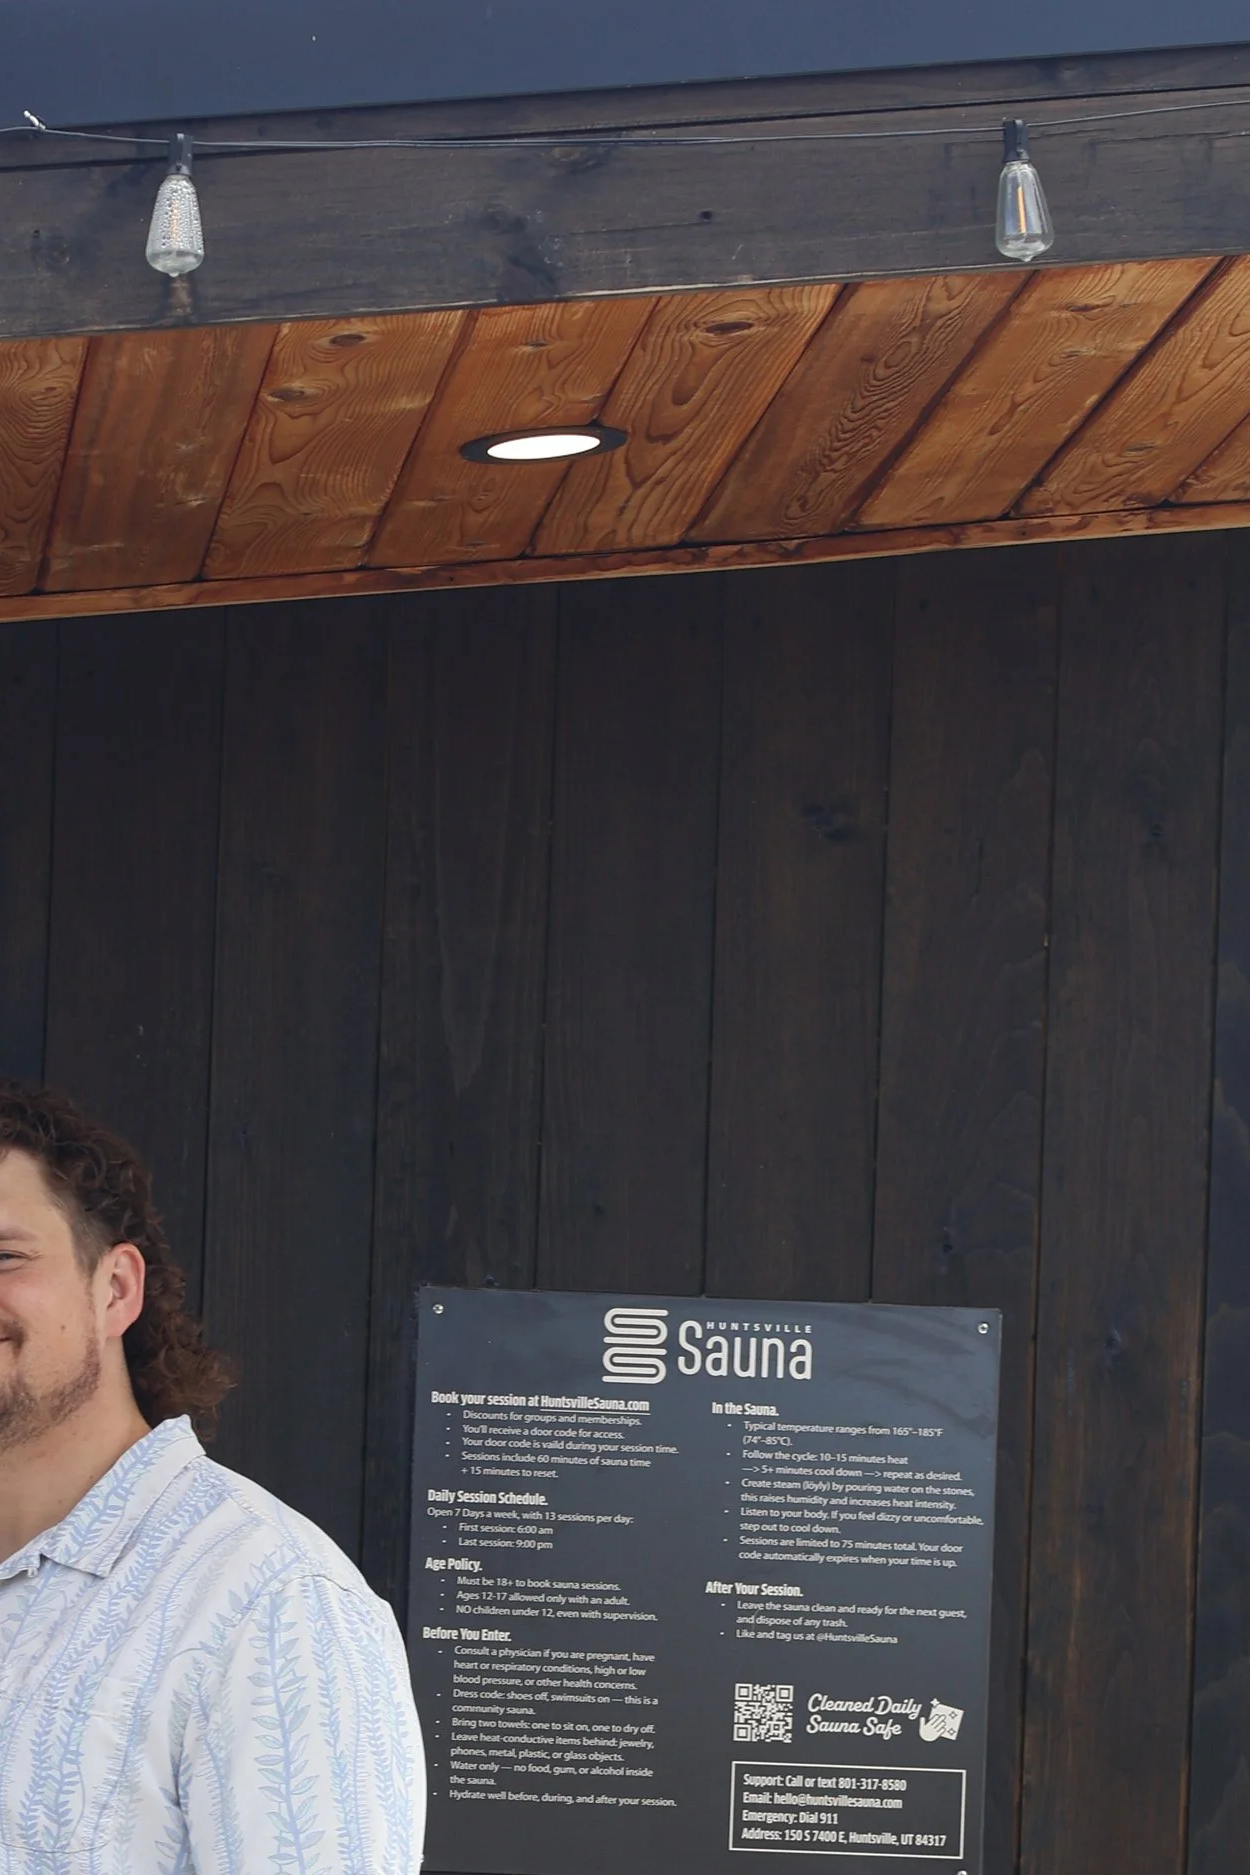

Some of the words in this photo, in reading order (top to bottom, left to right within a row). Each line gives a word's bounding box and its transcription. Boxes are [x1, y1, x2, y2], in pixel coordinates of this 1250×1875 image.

[706, 1321, 813, 1334] HUNTSVILLE
[678, 1320, 813, 1380] Sauna
[431, 1391, 459, 1403] Book
[460, 1394, 486, 1405] your
[486, 1394, 526, 1405] session
[527, 1395, 539, 1406] at
[540, 1395, 649, 1410] HuntsvilleSauna.com
[711, 1401, 723, 1413] In
[724, 1402, 742, 1414] the
[743, 1403, 779, 1416] Sauna.
[463, 1410, 508, 1420] Discounts
[509, 1411, 523, 1420] for
[523, 1414, 557, 1423] groups
[557, 1414, 576, 1422] and
[577, 1415, 642, 1426] memberships.
[743, 1420, 776, 1431] Typical
[776, 1423, 834, 1432] temperature
[835, 1426, 867, 1435] ranges
[867, 1425, 890, 1434] from
[461, 1437, 483, 1445] Your
[484, 1437, 507, 1446] door
[507, 1439, 531, 1448] code
[532, 1439, 540, 1448] is
[564, 1440, 596, 1452] during
[597, 1444, 619, 1452] your
[619, 1443, 654, 1452] session
[654, 1444, 678, 1453] time.
[742, 1449, 773, 1458] Follow
[774, 1450, 790, 1459] the
[791, 1452, 818, 1462] cycle:
[848, 1454, 886, 1463] minutes
[886, 1454, 908, 1464] heat
[427, 1489, 456, 1503] Daily
[456, 1490, 496, 1503] Session
[497, 1492, 548, 1505] Schedule.
[426, 1506, 453, 1517] Open
[454, 1508, 461, 1516] 7
[461, 1508, 484, 1519] Days
[493, 1510, 520, 1519] week,
[521, 1510, 542, 1519] with
[544, 1511, 556, 1520] 13
[556, 1512, 595, 1521] sessions
[595, 1515, 612, 1523] per
[612, 1514, 633, 1525] day:
[458, 1522, 478, 1531] First
[479, 1524, 515, 1532] session:
[516, 1525, 537, 1533] 6:00
[458, 1537, 477, 1546] Last
[478, 1538, 514, 1547] session:
[515, 1539, 536, 1548] 9:00
[536, 1541, 553, 1550] pm
[424, 1557, 446, 1570] Age
[447, 1558, 482, 1572] Policy.
[456, 1576, 480, 1585] Must
[481, 1576, 494, 1585] be
[496, 1577, 513, 1586] 18+
[526, 1578, 551, 1587] book
[551, 1581, 579, 1589] sauna
[580, 1581, 621, 1590] sessions.
[705, 1581, 733, 1593] After
[734, 1582, 759, 1594] Your
[760, 1583, 803, 1596] Session.
[455, 1590, 480, 1601] Ages
[481, 1591, 507, 1600] 12-17
[507, 1592, 545, 1602] allowed
[545, 1594, 567, 1604] only
[567, 1594, 589, 1603] with
[603, 1596, 630, 1605] adult.
[455, 1604, 471, 1613] NO
[472, 1605, 510, 1614] children
[511, 1607, 540, 1616] under
[541, 1608, 555, 1617] 12,
[579, 1609, 601, 1618] with
[602, 1611, 658, 1620] supervision.
[422, 1627, 458, 1639] Before
[459, 1628, 480, 1640] You
[480, 1629, 511, 1641] Enter.
[736, 1629, 755, 1638] Like
[755, 1630, 774, 1638] and
[775, 1631, 791, 1641] tag
[815, 1632, 898, 1643] @HuntsvilleSauna
[807, 1693, 874, 1713] Cleaned
[875, 1695, 922, 1719] Daily
[806, 1715, 861, 1733] Sauna
[862, 1717, 902, 1739] Safe
[451, 1732, 478, 1741] Leave
[479, 1733, 554, 1744] heat-conductive
[555, 1735, 581, 1745] items
[582, 1736, 618, 1746] behind:
[617, 1738, 654, 1749] jewelry,
[450, 1746, 487, 1756] phones,
[488, 1748, 517, 1757] metal,
[518, 1748, 550, 1759] plastic,
[563, 1750, 587, 1761] glass
[587, 1751, 624, 1762] objects.
[449, 1774, 465, 1784] the
[743, 1773, 784, 1786] Support:
[784, 1775, 803, 1786] Call
[804, 1777, 816, 1787] or
[816, 1776, 836, 1788] text
[837, 1777, 906, 1790] 801-317-8580
[742, 1791, 772, 1803] Email:
[773, 1792, 902, 1808] hello@huntsvillesauna.com
[742, 1809, 797, 1824] Emergency:
[798, 1811, 818, 1823] Dial
[819, 1812, 838, 1824] 911
[741, 1827, 782, 1840] Address:
[784, 1829, 802, 1840] 150
[803, 1829, 810, 1841] S
[811, 1830, 837, 1842] 7400
[838, 1831, 847, 1843] E,
[848, 1832, 899, 1845] Huntsville,
[900, 1833, 914, 1844] UT
[914, 1834, 946, 1846] 84317
